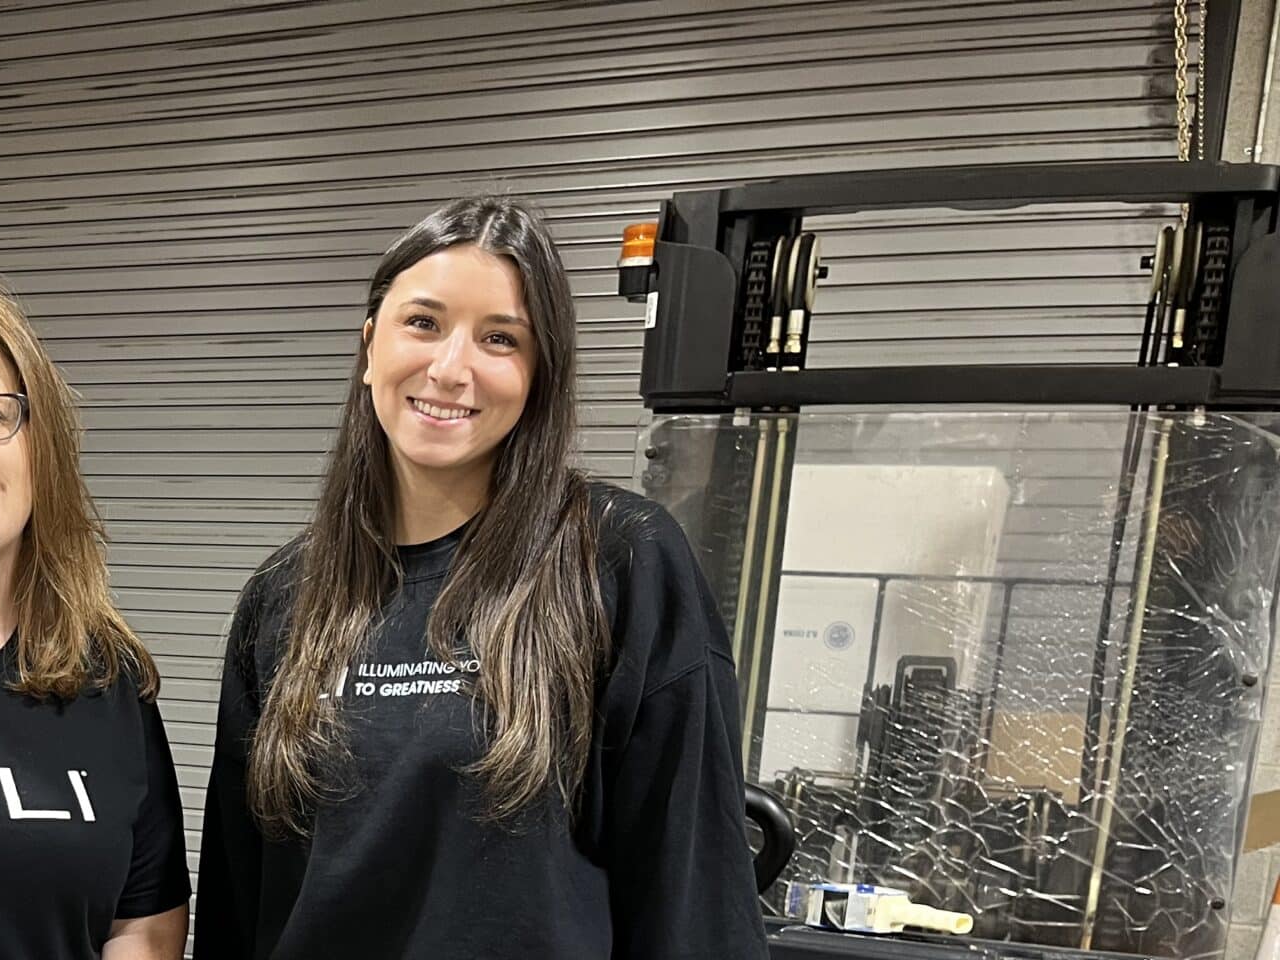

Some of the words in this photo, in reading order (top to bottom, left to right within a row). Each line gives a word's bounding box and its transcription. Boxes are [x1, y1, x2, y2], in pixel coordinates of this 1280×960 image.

[358, 661, 456, 678] ILLUMINATING
[460, 659, 480, 673] YO
[355, 682, 375, 696] TO
[379, 679, 460, 697] GREATNESS
